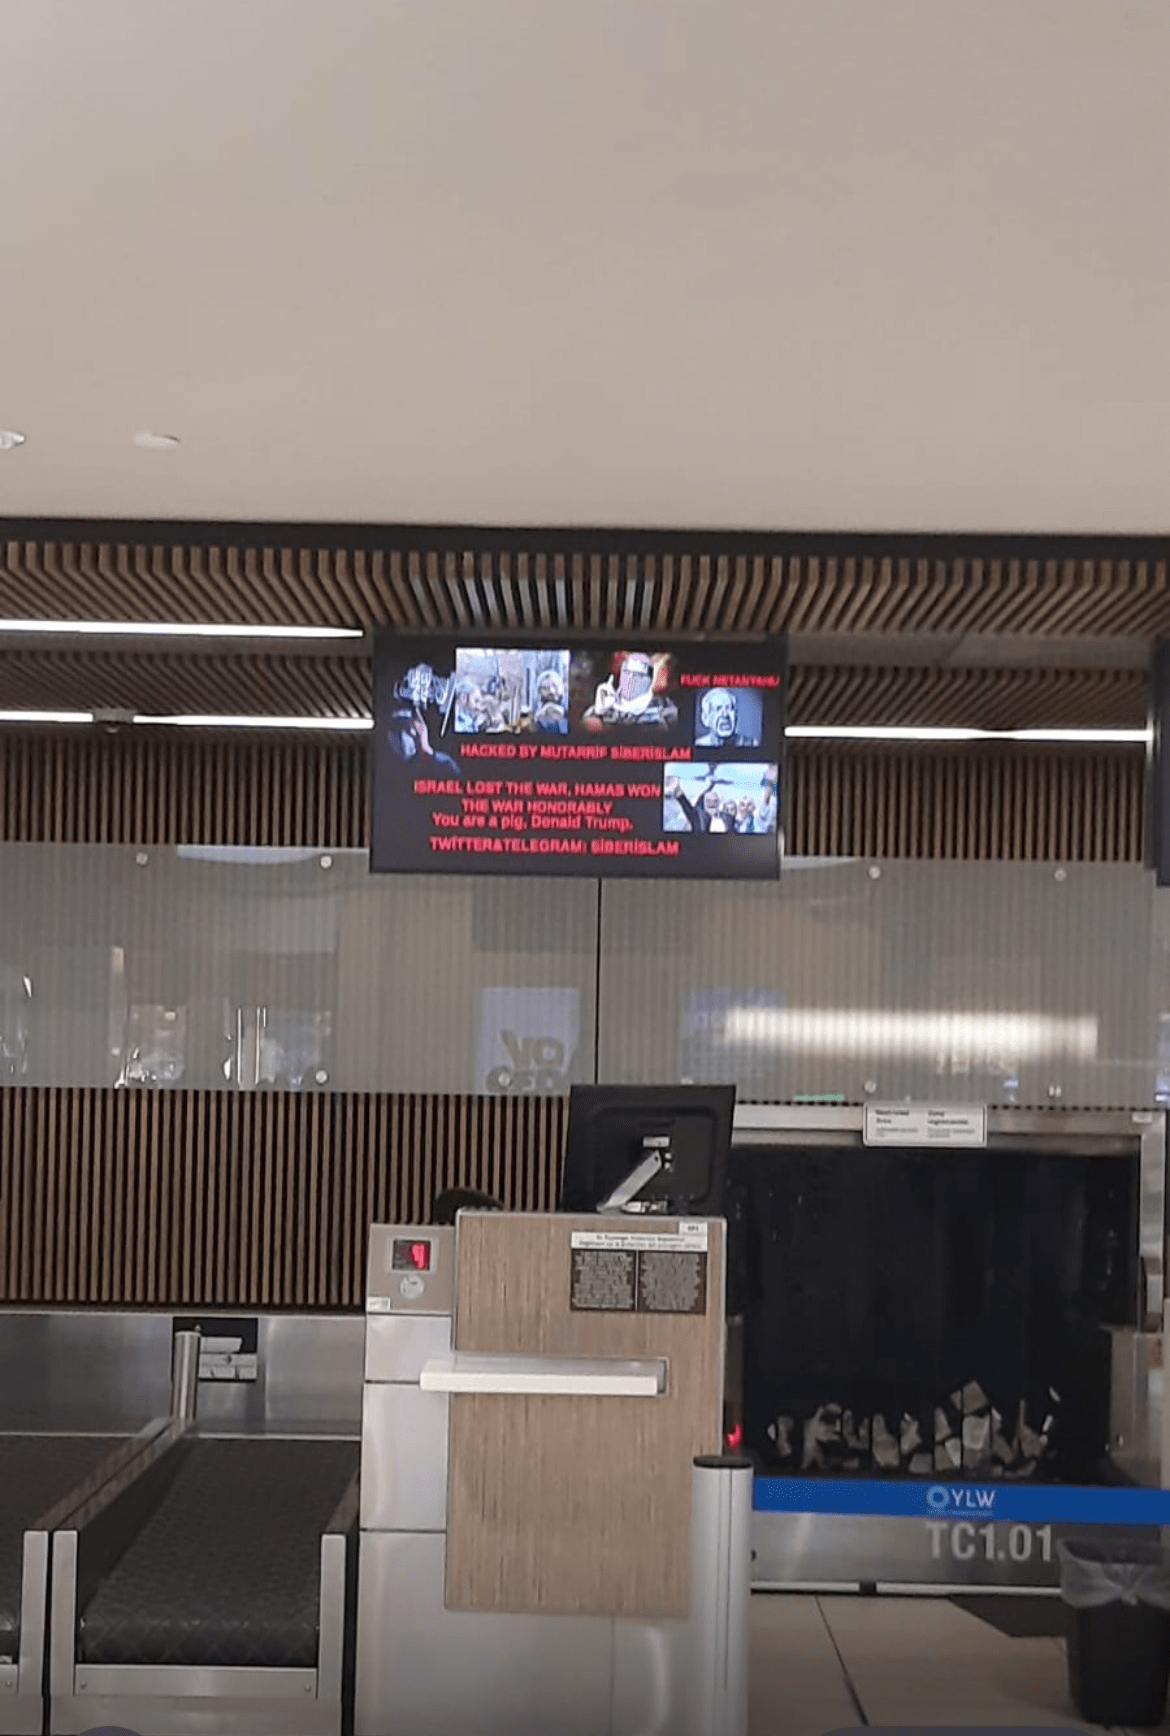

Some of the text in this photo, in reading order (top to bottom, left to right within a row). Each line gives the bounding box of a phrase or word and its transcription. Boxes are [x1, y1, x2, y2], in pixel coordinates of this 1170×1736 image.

[460, 742, 516, 758] HACKED
[519, 743, 538, 758] BY
[466, 780, 503, 796] LOST
[505, 780, 533, 796] THE
[574, 782, 626, 798] HAMAS
[627, 783, 661, 798] WON
[461, 798, 614, 815] THE WAR HONORABLY
[432, 811, 460, 828] You
[462, 814, 486, 829] are
[488, 814, 498, 829] a
[531, 813, 581, 830] Donald
[951, 1488, 996, 1508] YLW
[925, 1522, 1051, 1561] TC1.01
